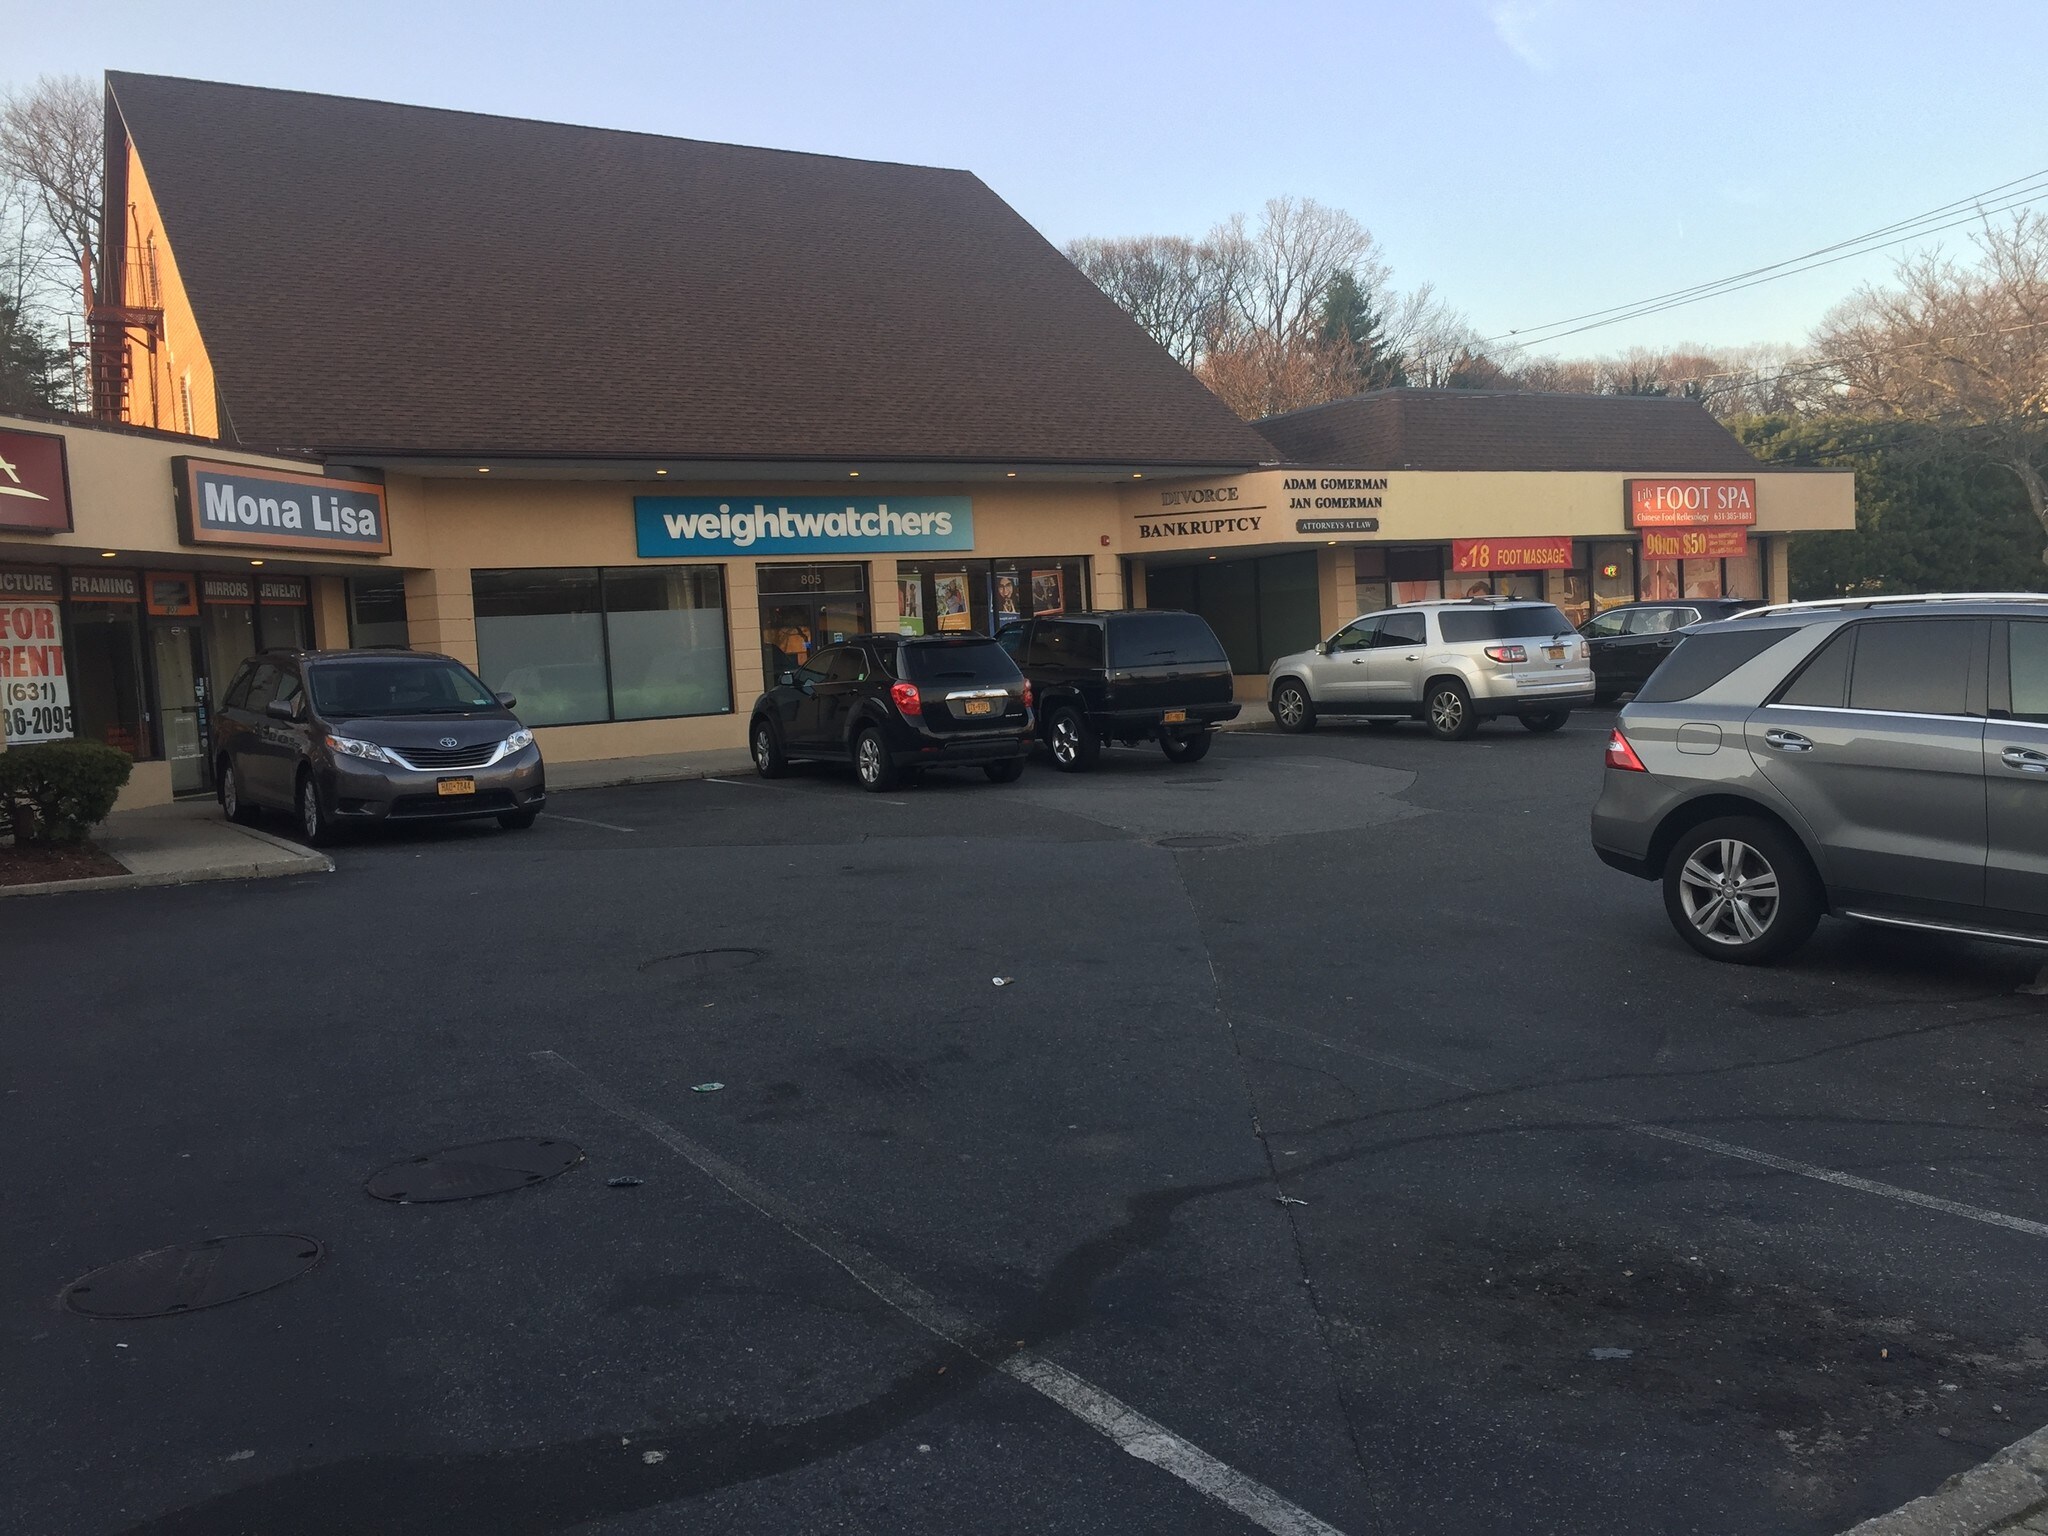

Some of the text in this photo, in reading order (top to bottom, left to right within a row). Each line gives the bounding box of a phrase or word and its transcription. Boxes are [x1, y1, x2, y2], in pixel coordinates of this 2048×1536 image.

[1283, 478, 1388, 490] ADAM GOMERMAN
[1161, 487, 1239, 506] DIVORCE
[1289, 497, 1383, 508] JAN GOMERMAN
[1656, 486, 1711, 510] FOOT
[1717, 486, 1751, 509] SPA
[204, 482, 377, 536] Mona Lisa
[1637, 513, 1661, 522] Chinese
[1676, 512, 1710, 523] Reflexology
[663, 503, 953, 547] weightwatchers
[1139, 516, 1262, 538] BANKRUPTCY
[1302, 520, 1372, 530] ATTORNEYS AT LAW
[1682, 532, 1707, 555] $50
[1497, 549, 1522, 565] FOOT
[1523, 548, 1565, 564] MASSAGE
[71, 577, 134, 594] FRAMING
[800, 574, 822, 585] 805
[205, 581, 249, 597] MIRRORS
[260, 584, 302, 598] JEWELRY
[0, 607, 55, 639] FOR
[0, 645, 64, 678] RENT
[7, 682, 56, 704] (631)
